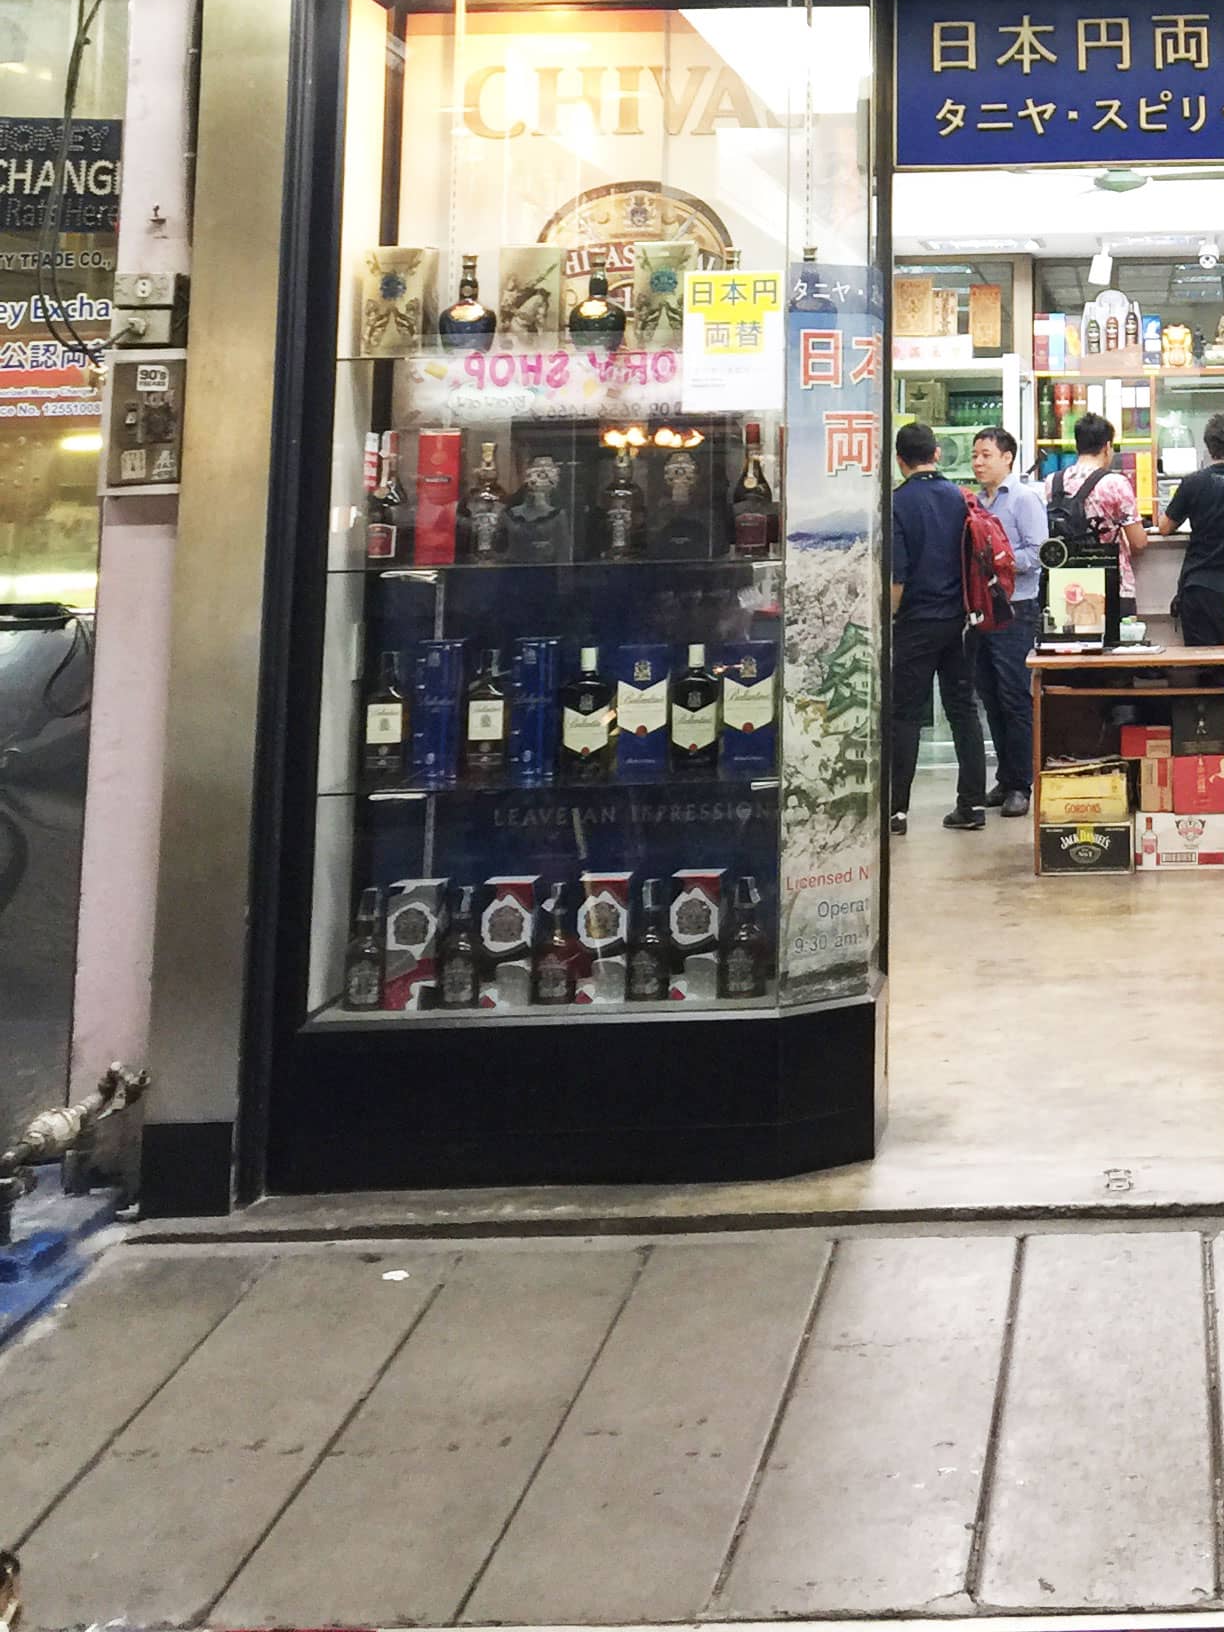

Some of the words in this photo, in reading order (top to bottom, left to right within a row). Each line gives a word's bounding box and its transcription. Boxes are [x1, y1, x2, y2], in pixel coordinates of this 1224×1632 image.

[462, 64, 806, 141] CHIVA
[691, 278, 778, 306] 日本円
[703, 321, 763, 348] 両替
[786, 867, 853, 891] Licensed
